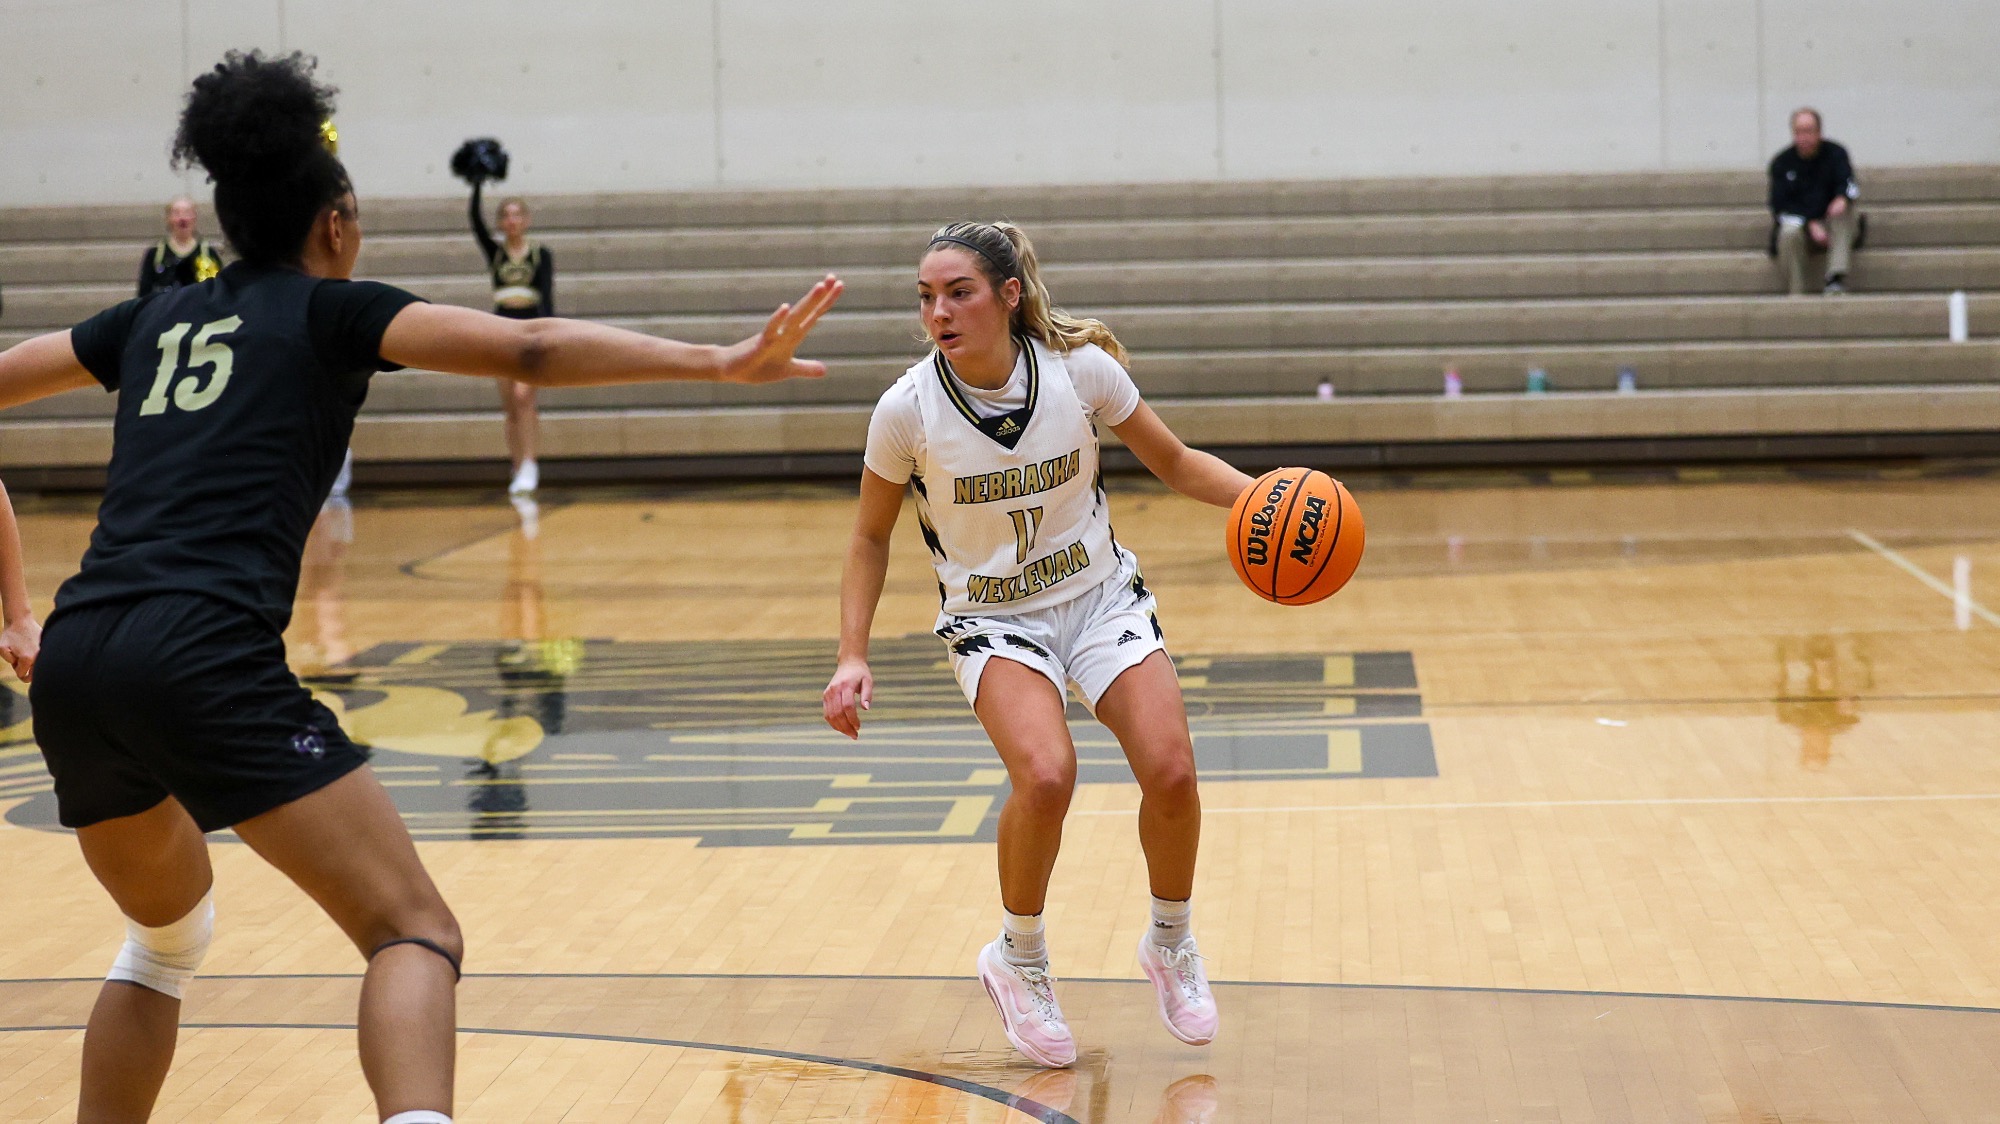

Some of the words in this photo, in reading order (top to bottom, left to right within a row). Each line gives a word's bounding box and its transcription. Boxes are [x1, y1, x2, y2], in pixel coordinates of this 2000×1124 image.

[139, 314, 244, 417] 15
[995, 425, 1021, 437] adidas
[953, 448, 1080, 505] NEBRASKA
[1007, 505, 1043, 564] 11
[1246, 478, 1295, 567] Wilson
[1289, 495, 1327, 566] NCAA
[967, 539, 1090, 604] WESLEYAN
[1117, 635, 1142, 646] adidas
